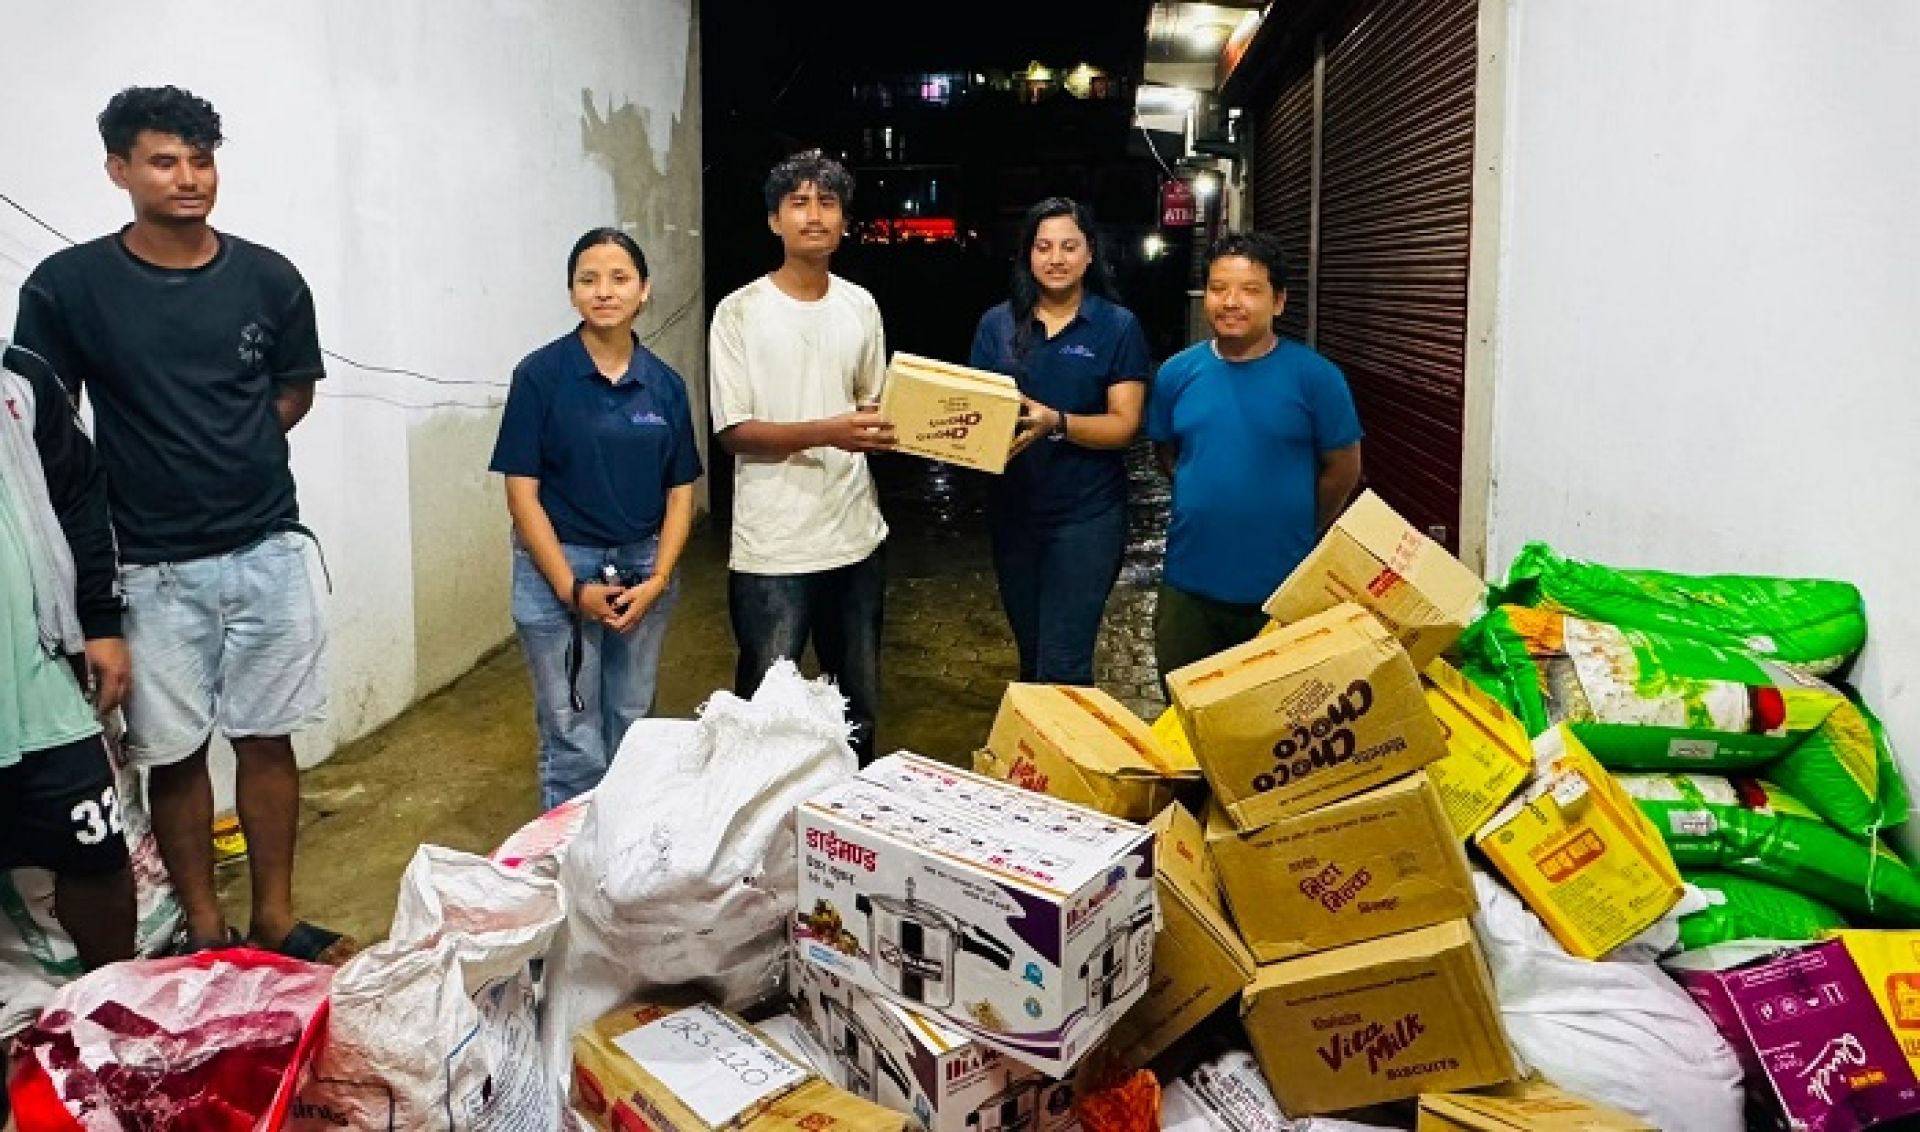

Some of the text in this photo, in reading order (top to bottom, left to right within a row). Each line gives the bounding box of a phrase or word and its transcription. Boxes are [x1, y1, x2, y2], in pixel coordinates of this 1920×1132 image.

[70, 786, 123, 845] 32
[1316, 1021, 1385, 1073] Vita
[1364, 1013, 1425, 1075] Milk
[1385, 1057, 1460, 1081] BISCUITS
